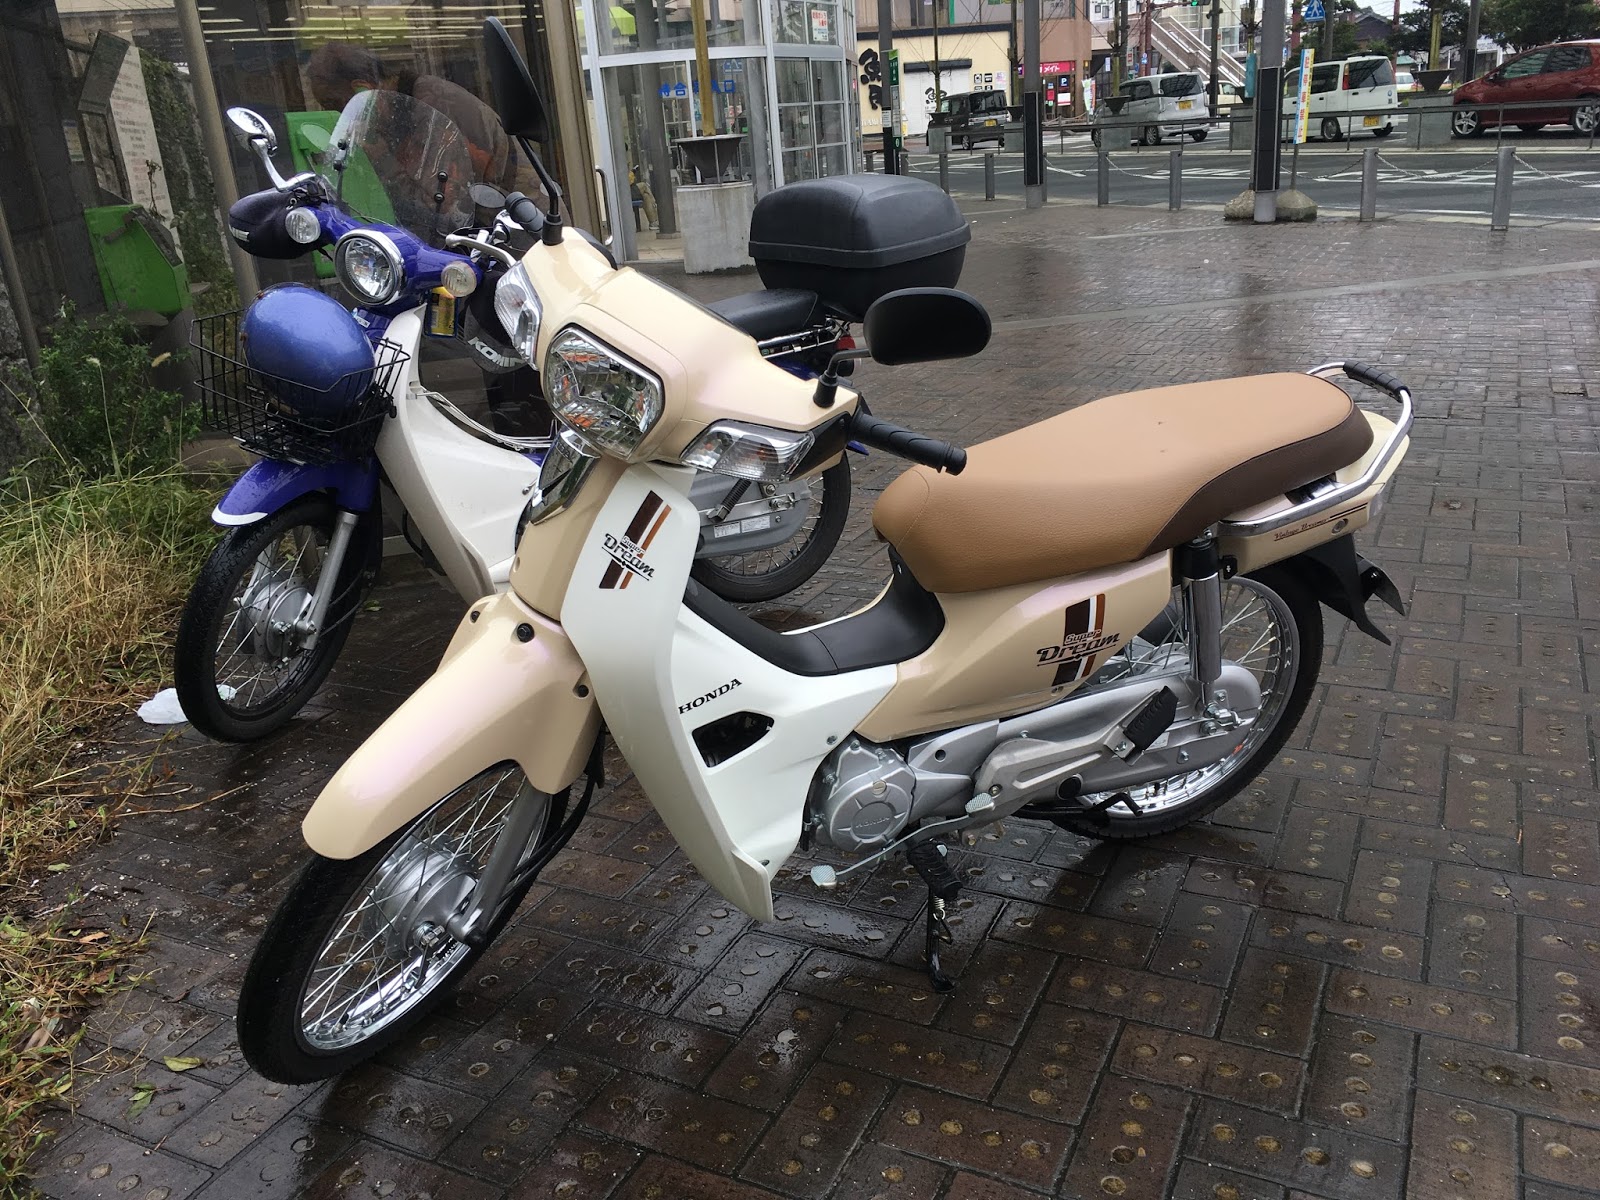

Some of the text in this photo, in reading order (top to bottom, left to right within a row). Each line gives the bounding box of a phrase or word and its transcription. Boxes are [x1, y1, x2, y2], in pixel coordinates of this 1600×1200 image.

[1061, 77, 1068, 85] P
[603, 533, 656, 578] Dream
[621, 535, 646, 554] Super
[1036, 633, 1120, 662] Dream
[1064, 629, 1102, 645] Super
[678, 678, 743, 715] HONDA
